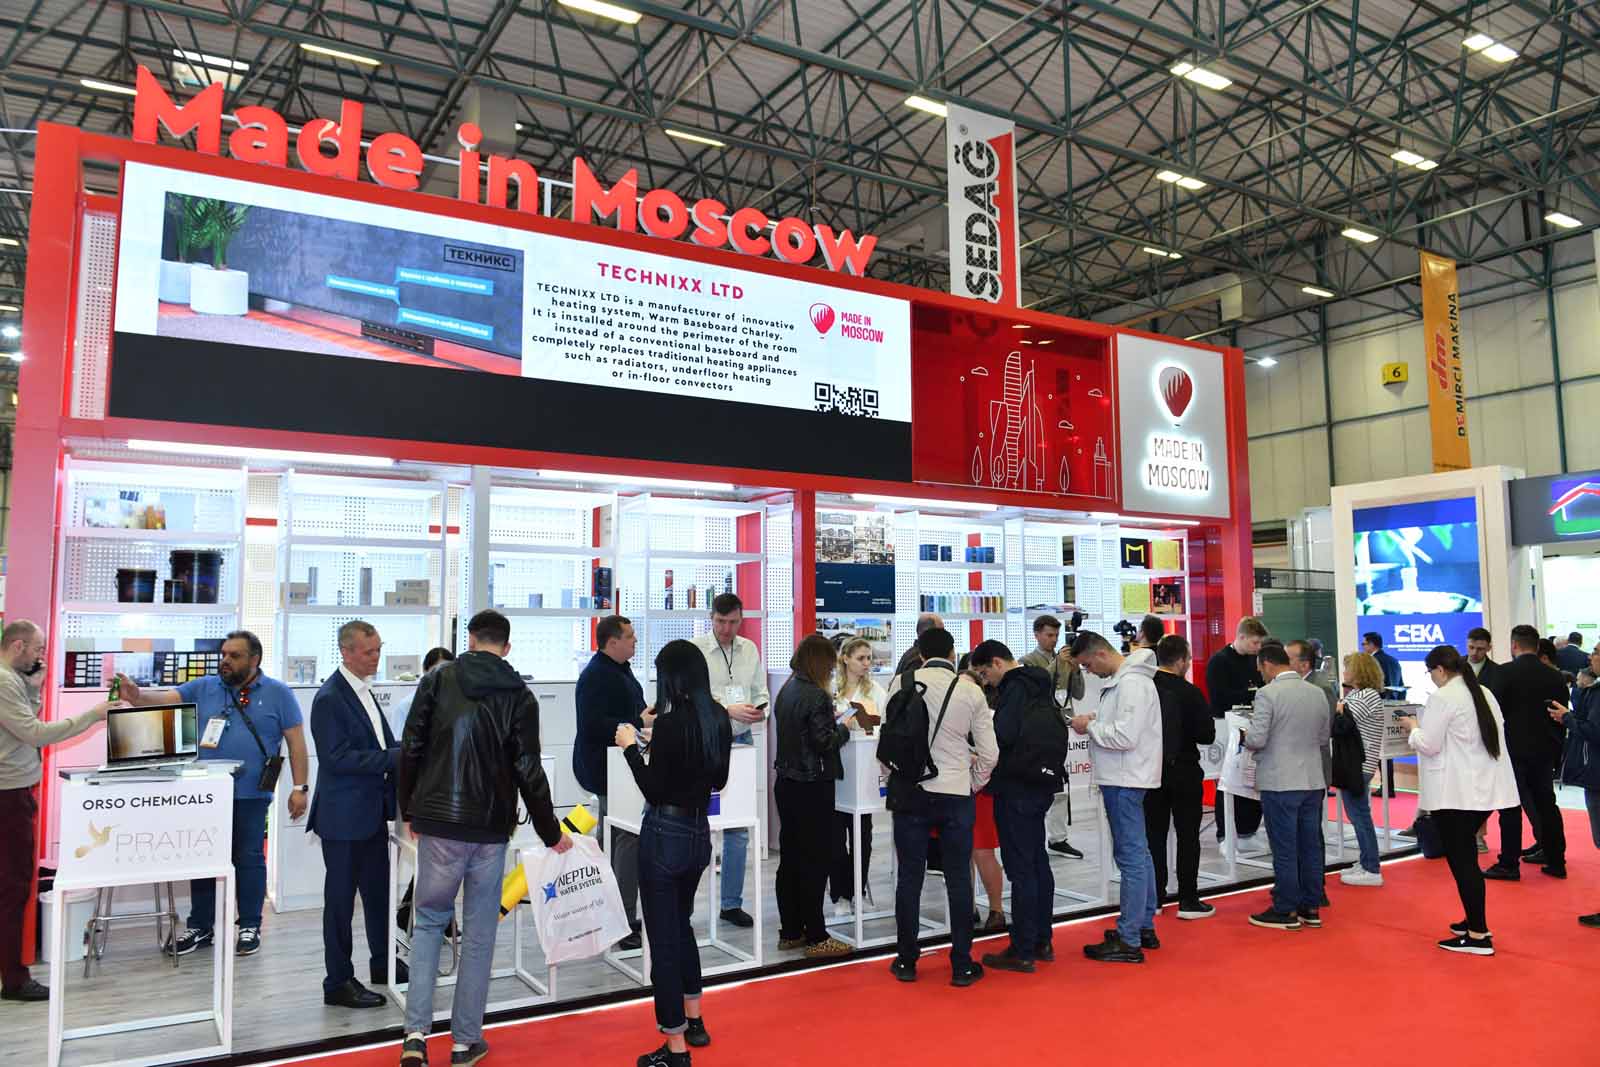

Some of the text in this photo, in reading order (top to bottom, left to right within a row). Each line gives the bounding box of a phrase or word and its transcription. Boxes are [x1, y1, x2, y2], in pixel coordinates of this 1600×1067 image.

[132, 64, 878, 277] Made in Moscow
[954, 140, 999, 301] SEDAĞ
[449, 248, 511, 267] ТЕКНИКС
[597, 262, 744, 299] TECHNIXX LTD
[537, 282, 596, 299] TECHNIXX
[600, 293, 620, 303] LTD
[624, 296, 634, 305] is
[648, 302, 721, 319] manufacturer
[725, 312, 736, 321] of
[742, 314, 795, 331] innovative
[552, 297, 783, 341] heating system, Warm Baseboard Charley.
[841, 312, 872, 326] MADE IN
[533, 307, 798, 353] It is installed around the perimeter of the room
[555, 323, 598, 337] instead
[603, 330, 615, 339] of
[629, 335, 701, 352] conventional
[704, 344, 758, 359] baseboard
[762, 353, 780, 363] and
[841, 324, 884, 343] MOSCOW
[532, 335, 798, 377] completely replaces traditional heating appliances
[564, 351, 591, 362] such
[612, 358, 668, 373] radiators,
[672, 365, 729, 380] underfloor
[733, 372, 772, 386] heating
[612, 370, 734, 392] or in-floor convectors
[1392, 366, 1401, 378] 6
[1154, 438, 1203, 462] MADE IN
[1148, 463, 1209, 491] MOSCOW
[82, 793, 214, 810] ORSO CHEMICALS
[560, 884, 578, 896] WATER
